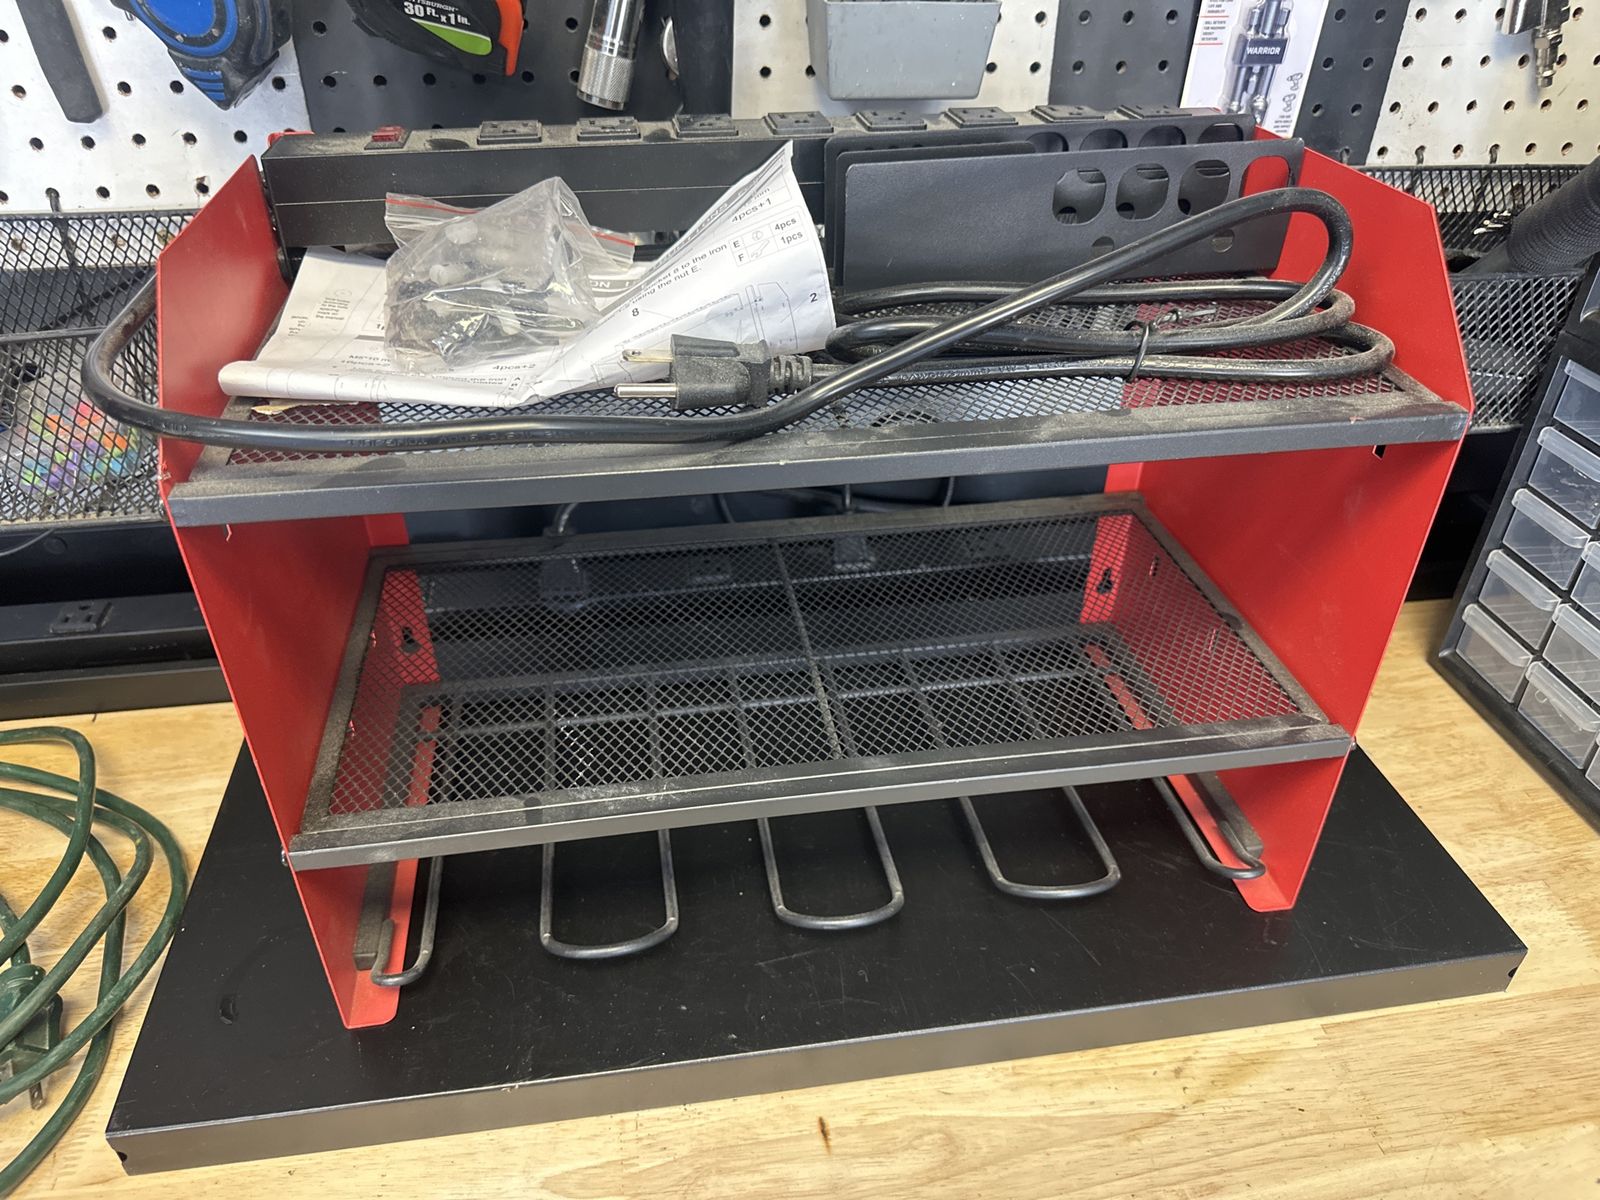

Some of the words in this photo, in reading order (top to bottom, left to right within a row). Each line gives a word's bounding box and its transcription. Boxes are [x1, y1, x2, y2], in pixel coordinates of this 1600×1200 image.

[403, 1, 425, 17] 30
[448, 13, 456, 25] 1
[408, 0, 455, 12] TSBURGH
[1246, 46, 1281, 55] WARRIOR
[732, 197, 772, 223] 4pcs+1
[733, 240, 740, 248] E
[774, 218, 797, 231] 4pcs
[681, 262, 690, 270] to
[692, 253, 707, 263] the
[708, 243, 728, 256] iron
[738, 253, 744, 262] F
[781, 231, 803, 244] 1pcs
[657, 278, 672, 289] the
[674, 271, 690, 281] nut
[810, 292, 818, 303] 2
[632, 307, 640, 317] 8
